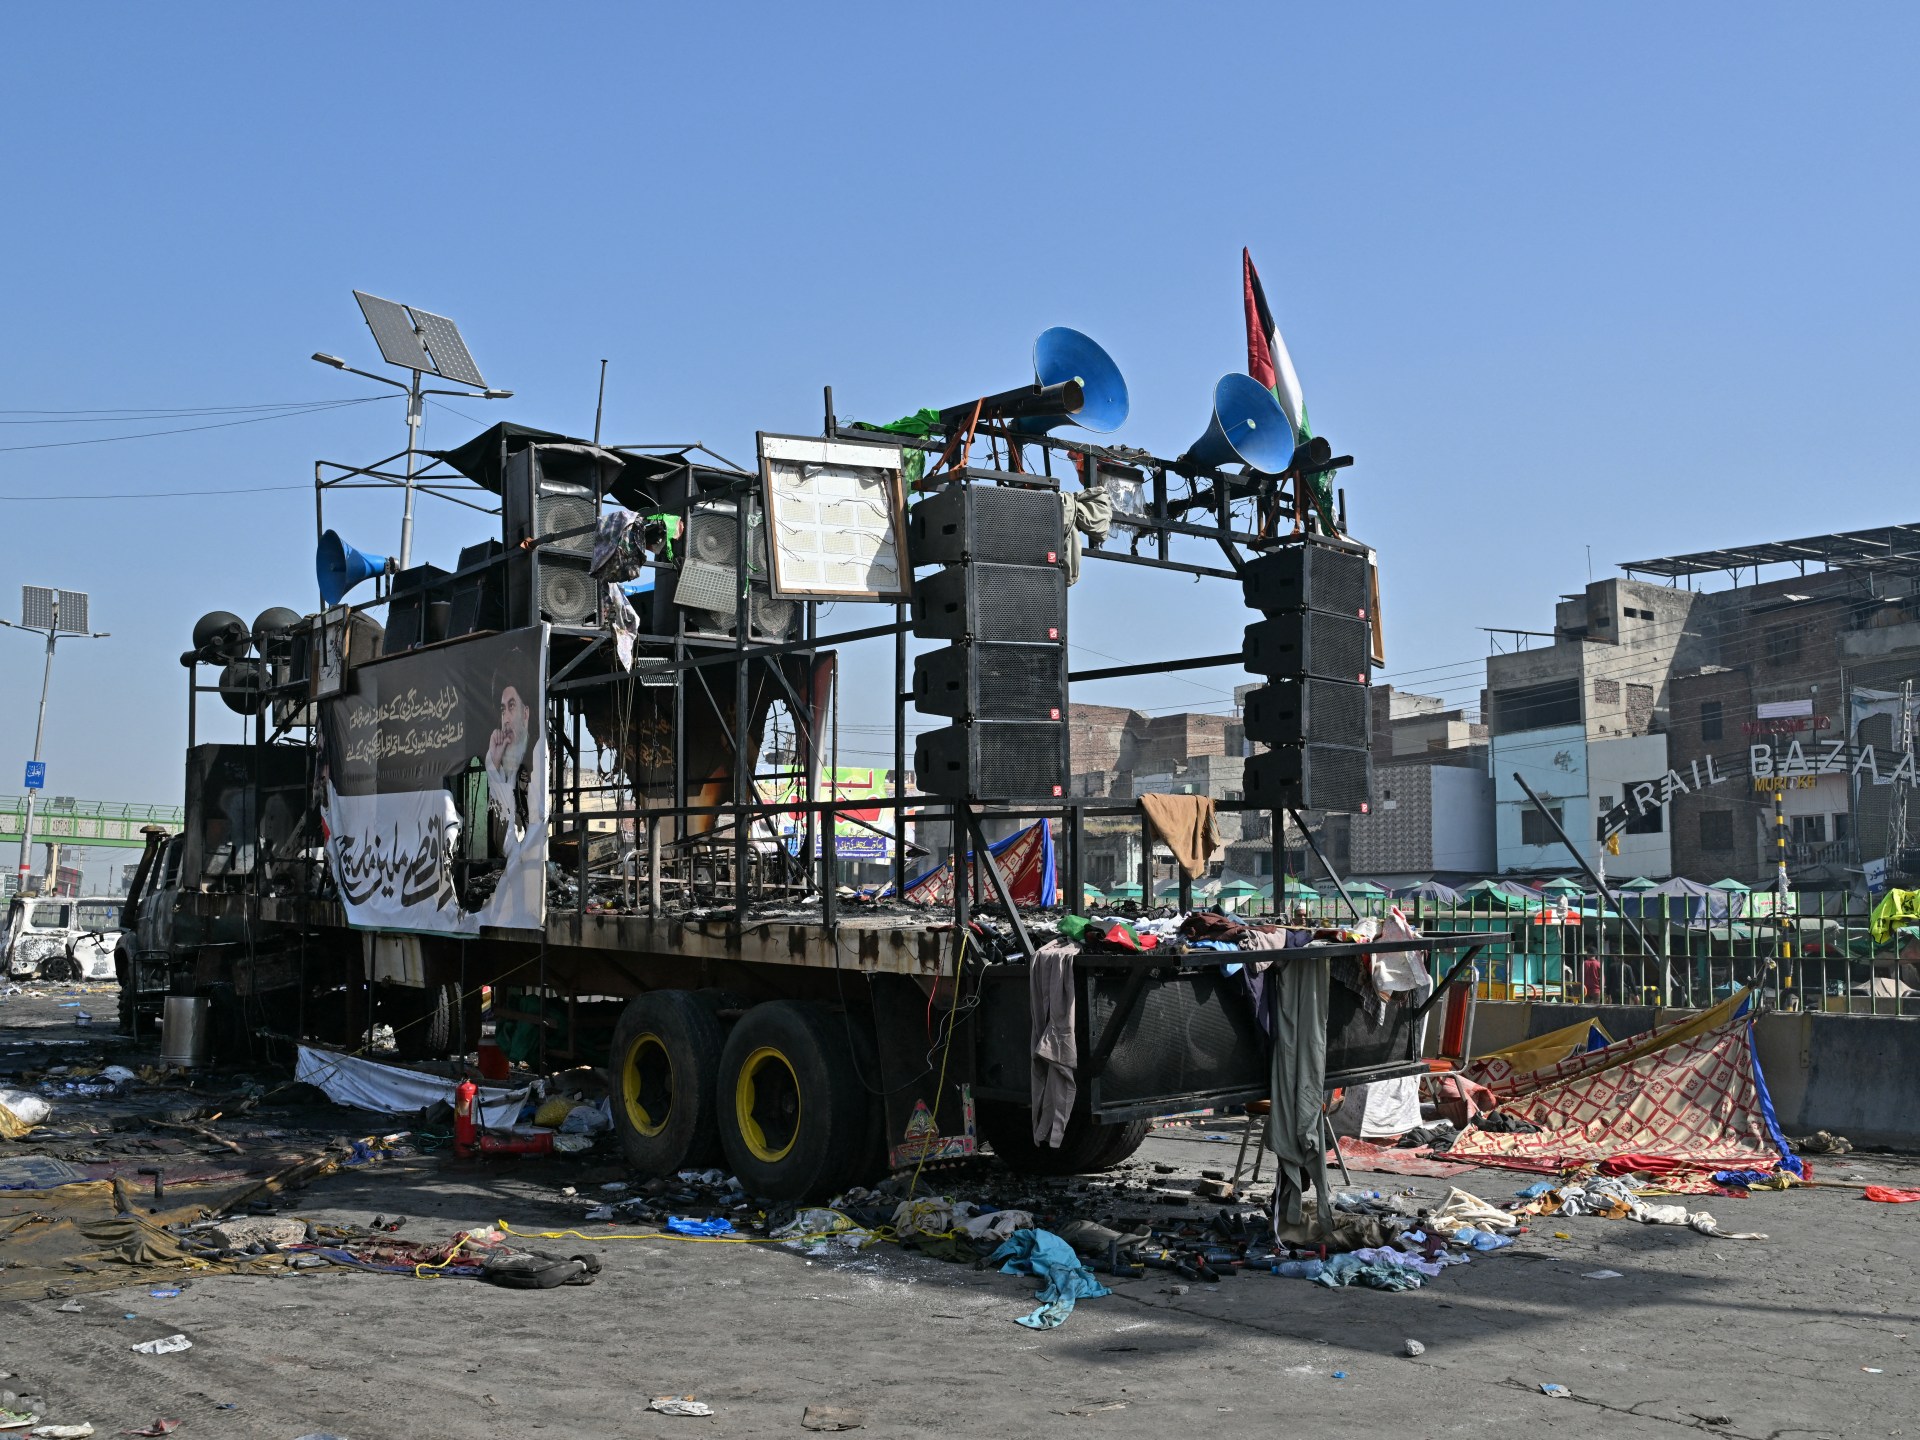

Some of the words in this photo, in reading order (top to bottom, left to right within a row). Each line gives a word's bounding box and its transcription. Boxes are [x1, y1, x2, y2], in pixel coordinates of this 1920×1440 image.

[389, 694, 402, 720] کے
[1741, 719, 1808, 736] WELCOME
[1632, 755, 1726, 816] RAIL
